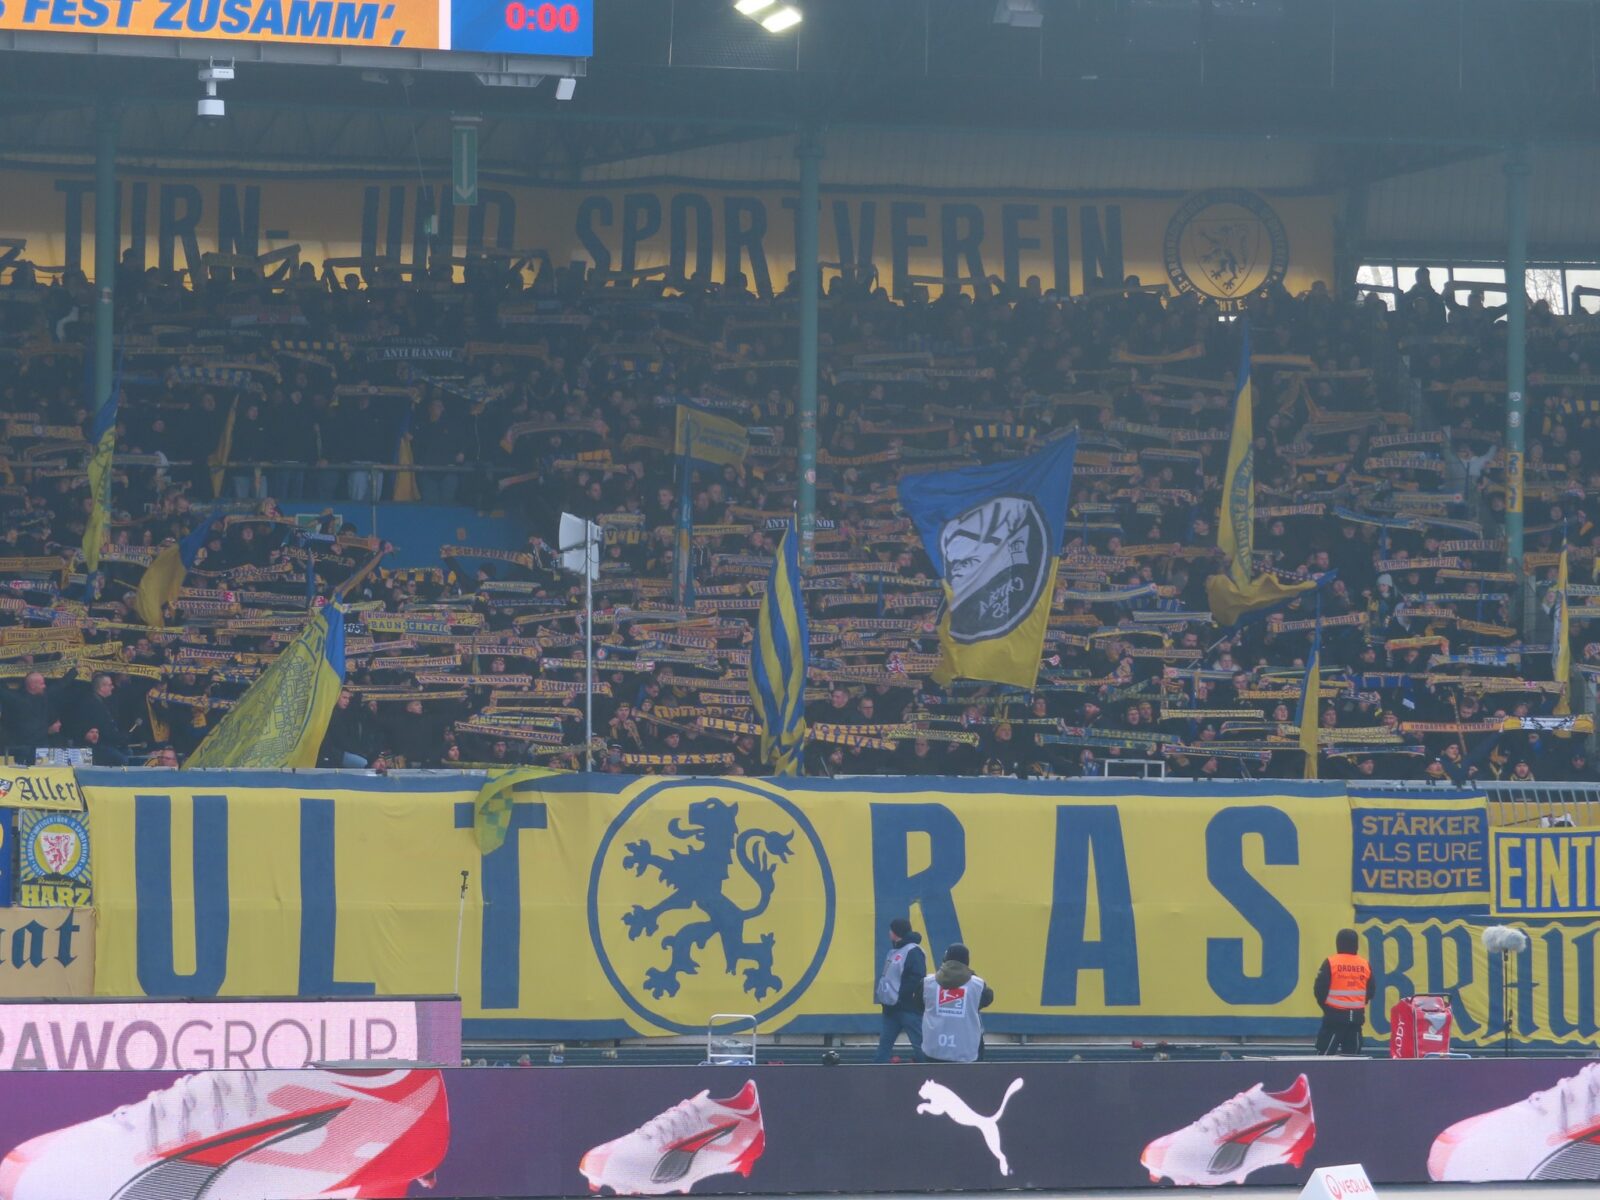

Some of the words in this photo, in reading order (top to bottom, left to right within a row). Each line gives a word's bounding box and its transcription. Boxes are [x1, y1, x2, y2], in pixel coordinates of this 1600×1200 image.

[22, 0, 141, 30] FEST
[505, 3, 578, 33] 0:00
[15, 776, 76, 801] Aller
[1361, 812, 1481, 837] STÄRKER
[1362, 842, 1411, 862] ALS
[1418, 841, 1482, 861] EURE
[1362, 868, 1482, 888] VERBOTE
[1500, 836, 1600, 908] EINT
[21, 884, 91, 907] HARZ
[0, 1020, 398, 1070] AWOGROUP
[938, 1033, 957, 1048] 01
[1339, 1178, 1372, 1194] VEOLIA
